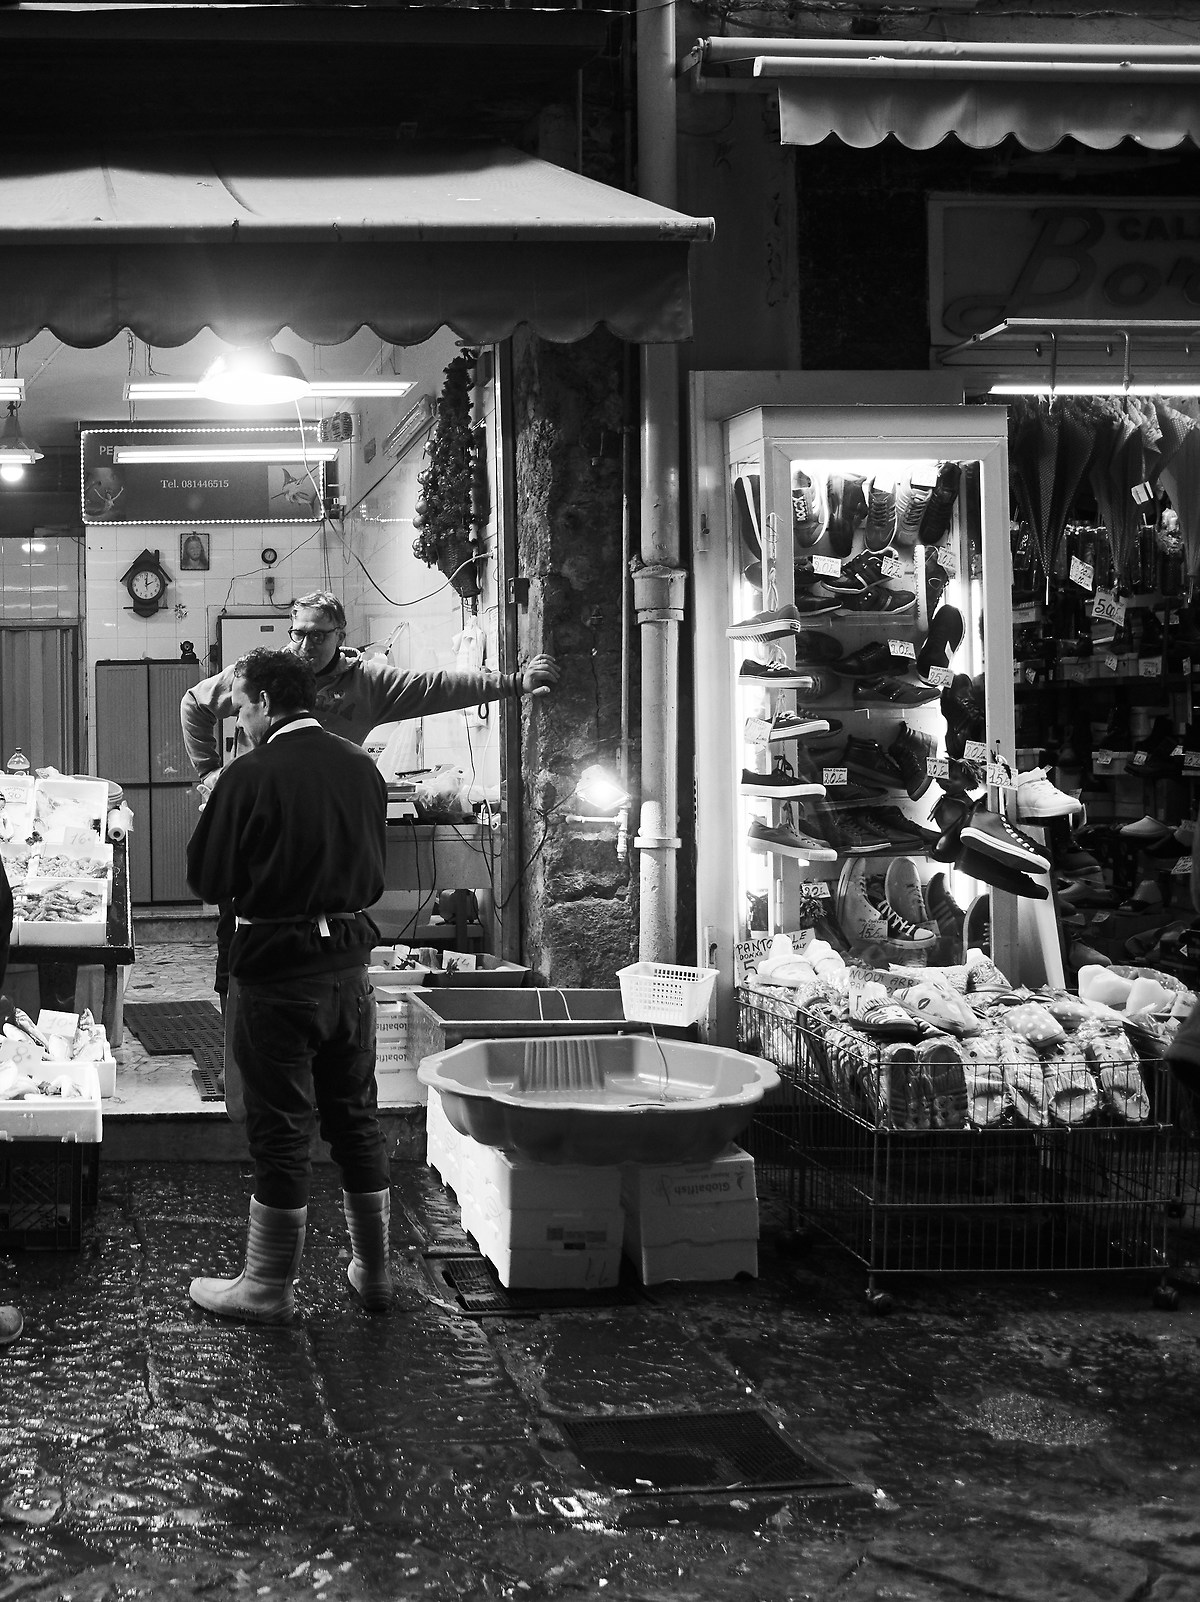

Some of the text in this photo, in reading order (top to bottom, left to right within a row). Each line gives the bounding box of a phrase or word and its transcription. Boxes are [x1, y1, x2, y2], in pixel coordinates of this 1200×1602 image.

[1118, 216, 1200, 241] CAL
[160, 479, 230, 489] Tel. 081446515
[735, 930, 808, 955] PANTOLE
[375, 1022, 408, 1032] lobalfis
[375, 1053, 408, 1062] lobalfis
[674, 1182, 731, 1197] Globalfish
